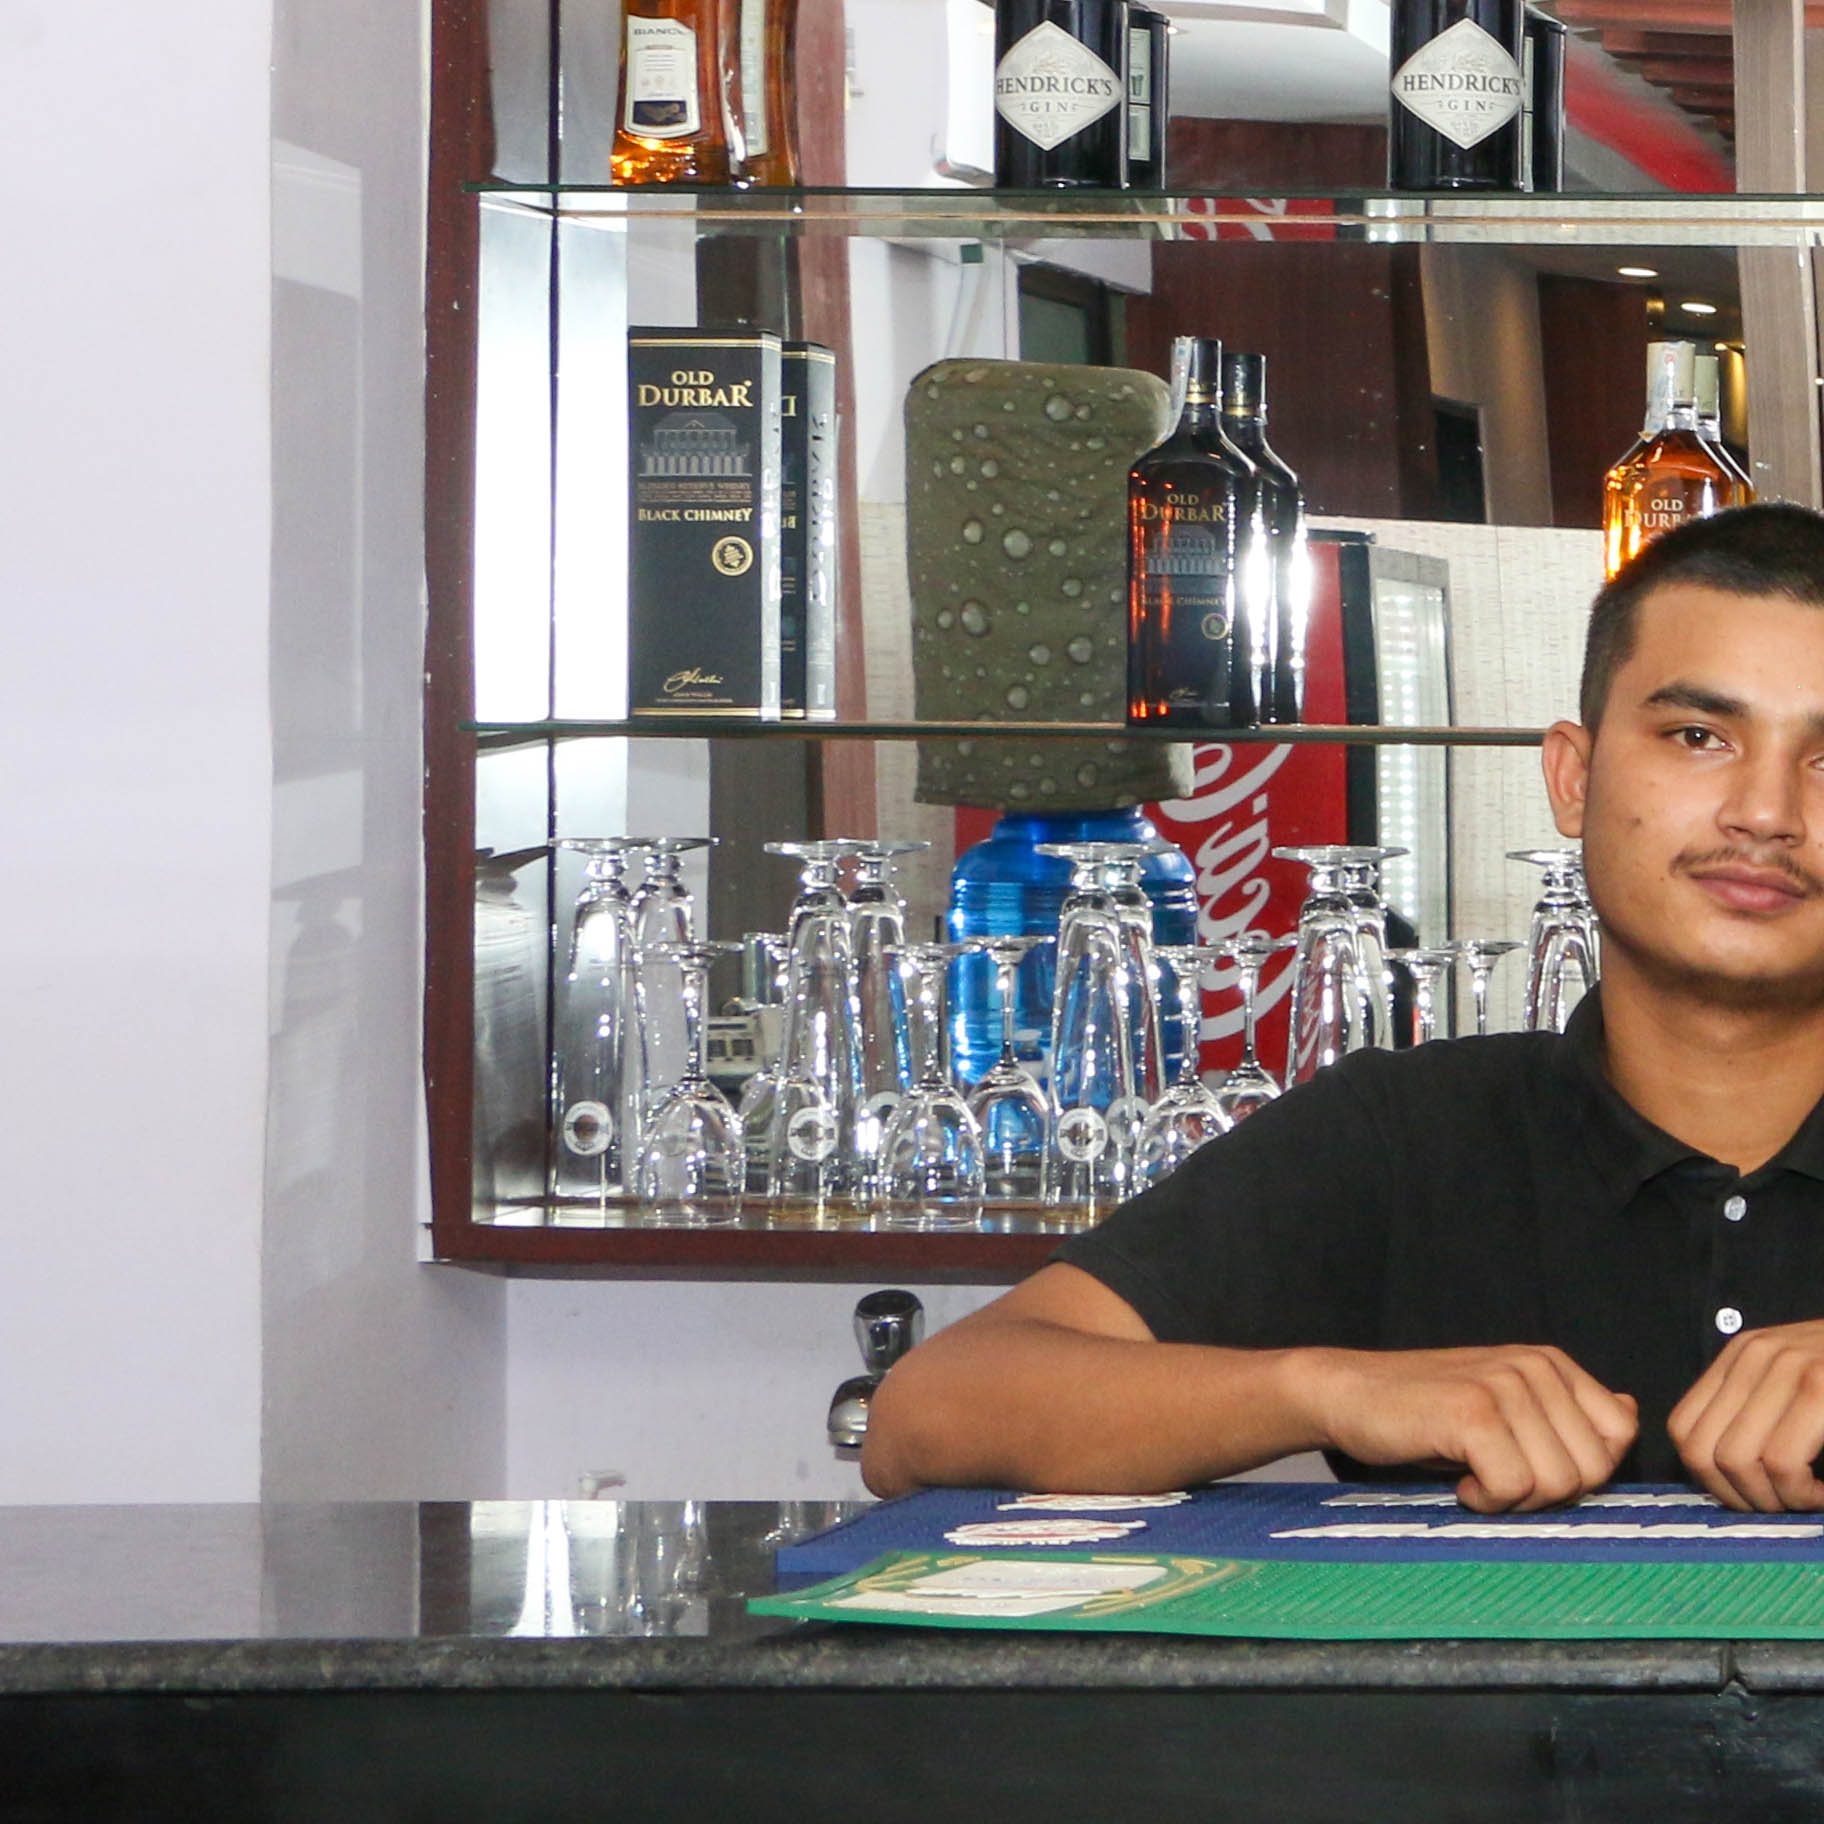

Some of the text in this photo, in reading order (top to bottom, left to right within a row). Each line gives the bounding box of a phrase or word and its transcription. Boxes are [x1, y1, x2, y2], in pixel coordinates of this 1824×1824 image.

[996, 75, 1113, 97] HENDRICK'S
[1402, 73, 1521, 97] HENDRICK'S
[1029, 101, 1069, 113] GIN
[1447, 99, 1487, 112] GIN
[671, 370, 715, 386] OLD
[637, 383, 754, 407] DURBAR
[1167, 494, 1200, 506] OLD
[1650, 498, 1684, 512] OLD
[638, 508, 753, 522] BLACK CHIMNEY
